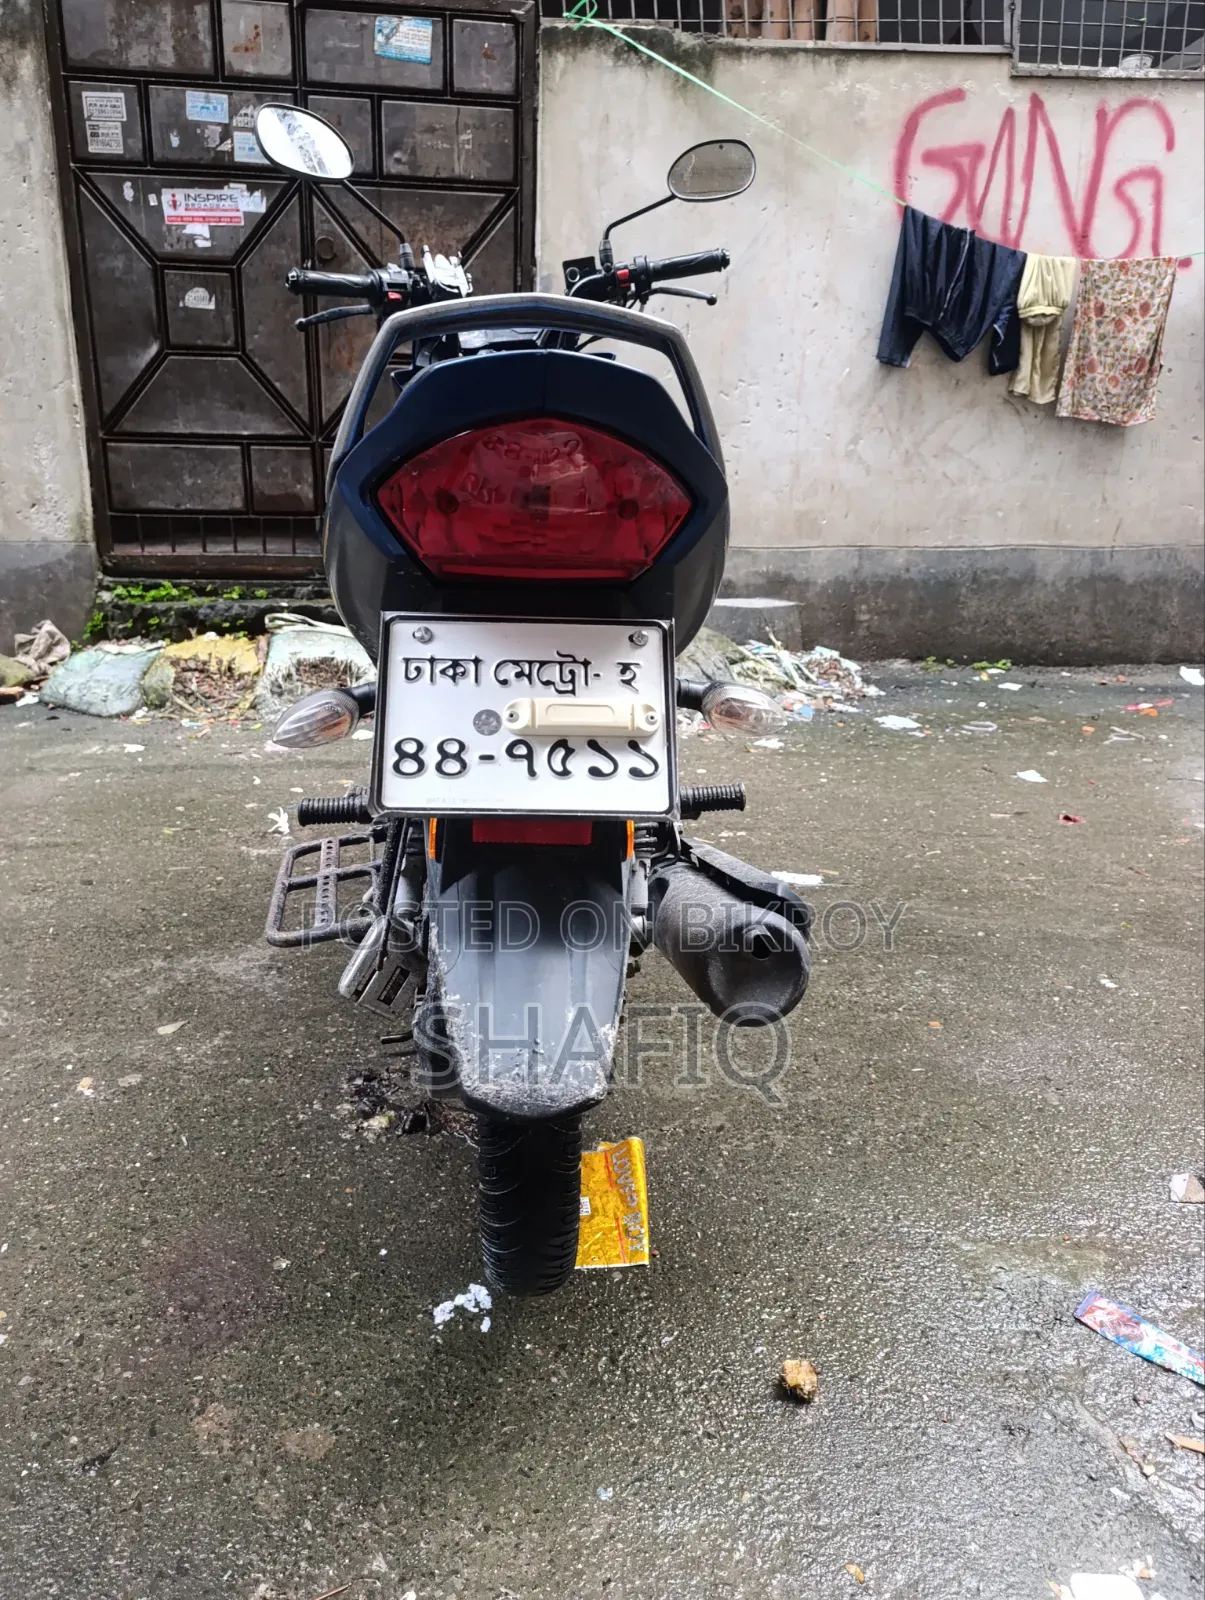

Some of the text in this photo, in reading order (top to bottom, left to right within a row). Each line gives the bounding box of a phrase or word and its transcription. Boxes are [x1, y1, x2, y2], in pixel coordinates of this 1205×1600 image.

[894, 87, 1177, 263] GANG
[184, 193, 238, 203] INSPIRE
[402, 655, 483, 686] ঢাকা
[617, 661, 641, 694] হ
[392, 737, 660, 779] ৪৪-৭৫১১
[622, 1210, 646, 1252] BOY
